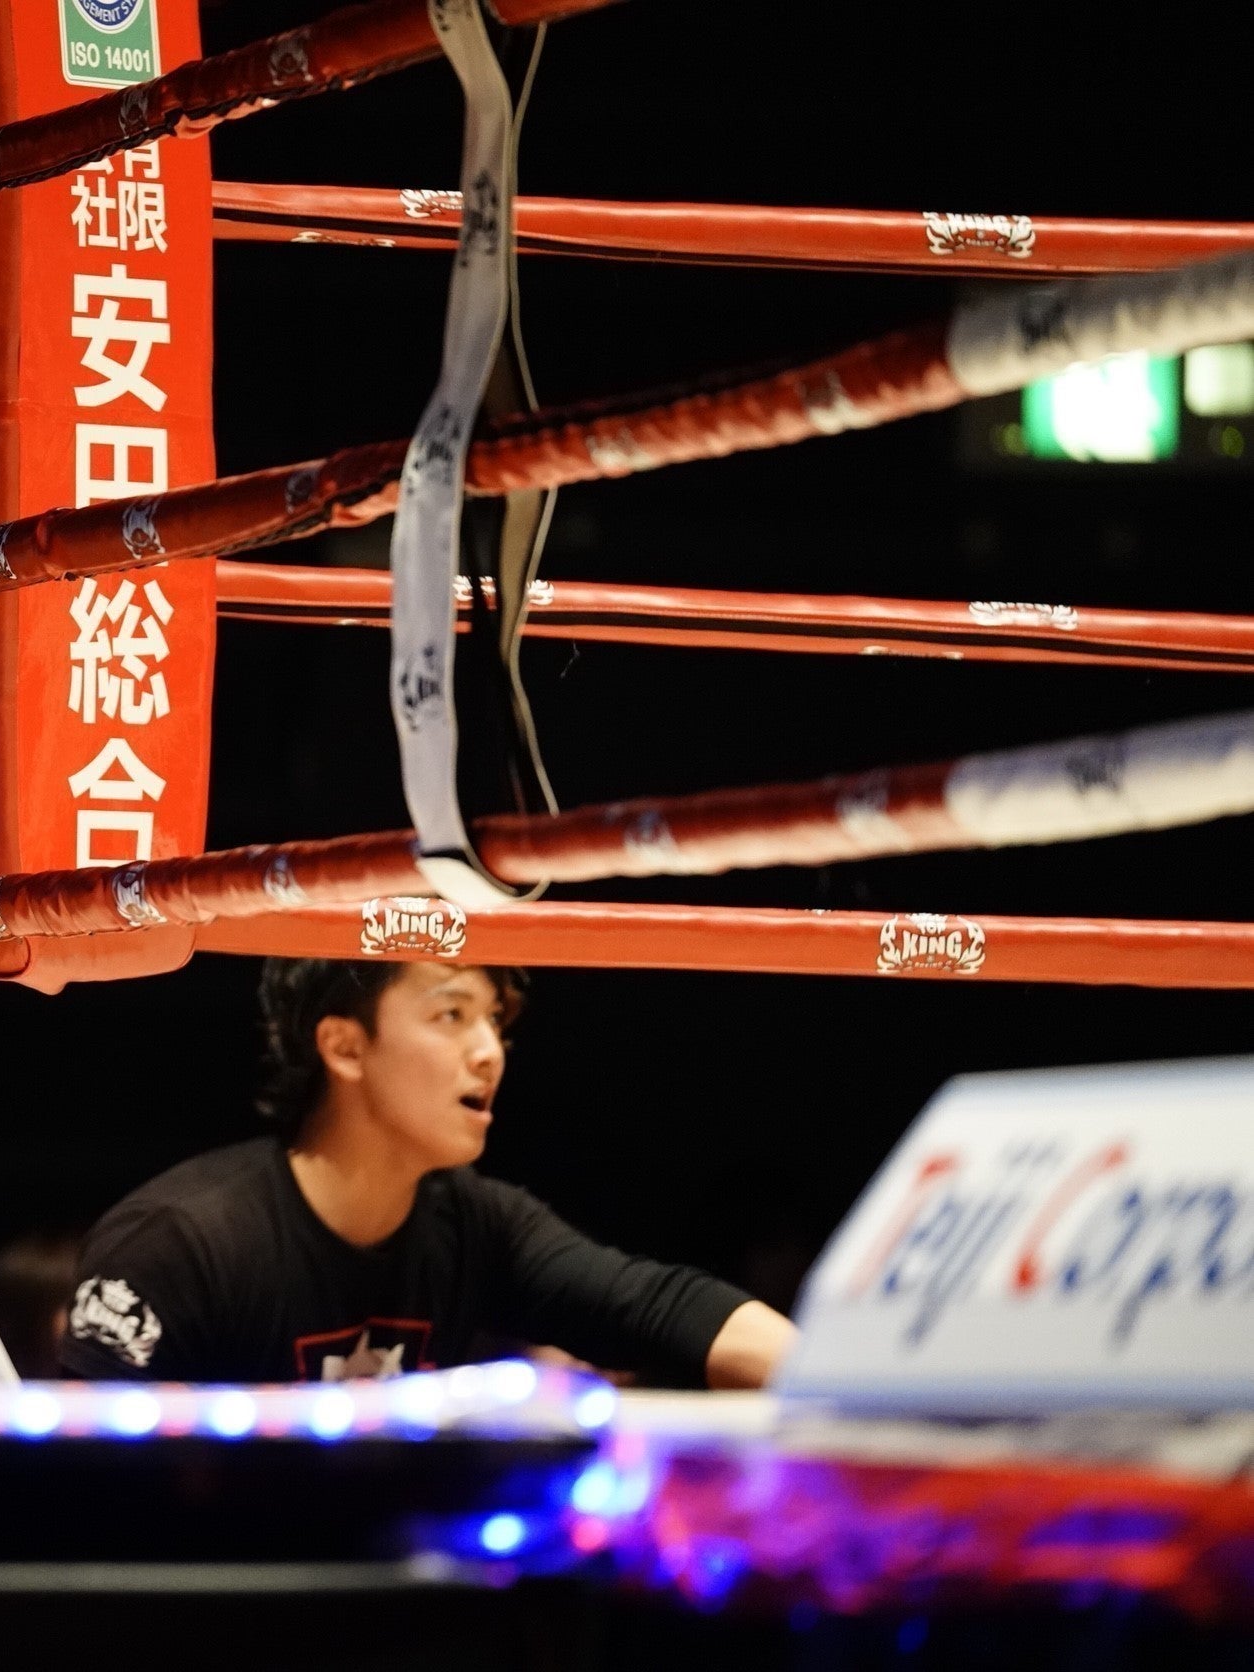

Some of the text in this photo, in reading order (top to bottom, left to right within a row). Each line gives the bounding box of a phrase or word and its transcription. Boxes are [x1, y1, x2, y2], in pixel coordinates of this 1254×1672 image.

[79, 0, 121, 21] GEMENT
[71, 41, 151, 73] ISO 14001
[384, 907, 444, 942] KING
[916, 921, 947, 935] TOP
[902, 929, 962, 961] KING
